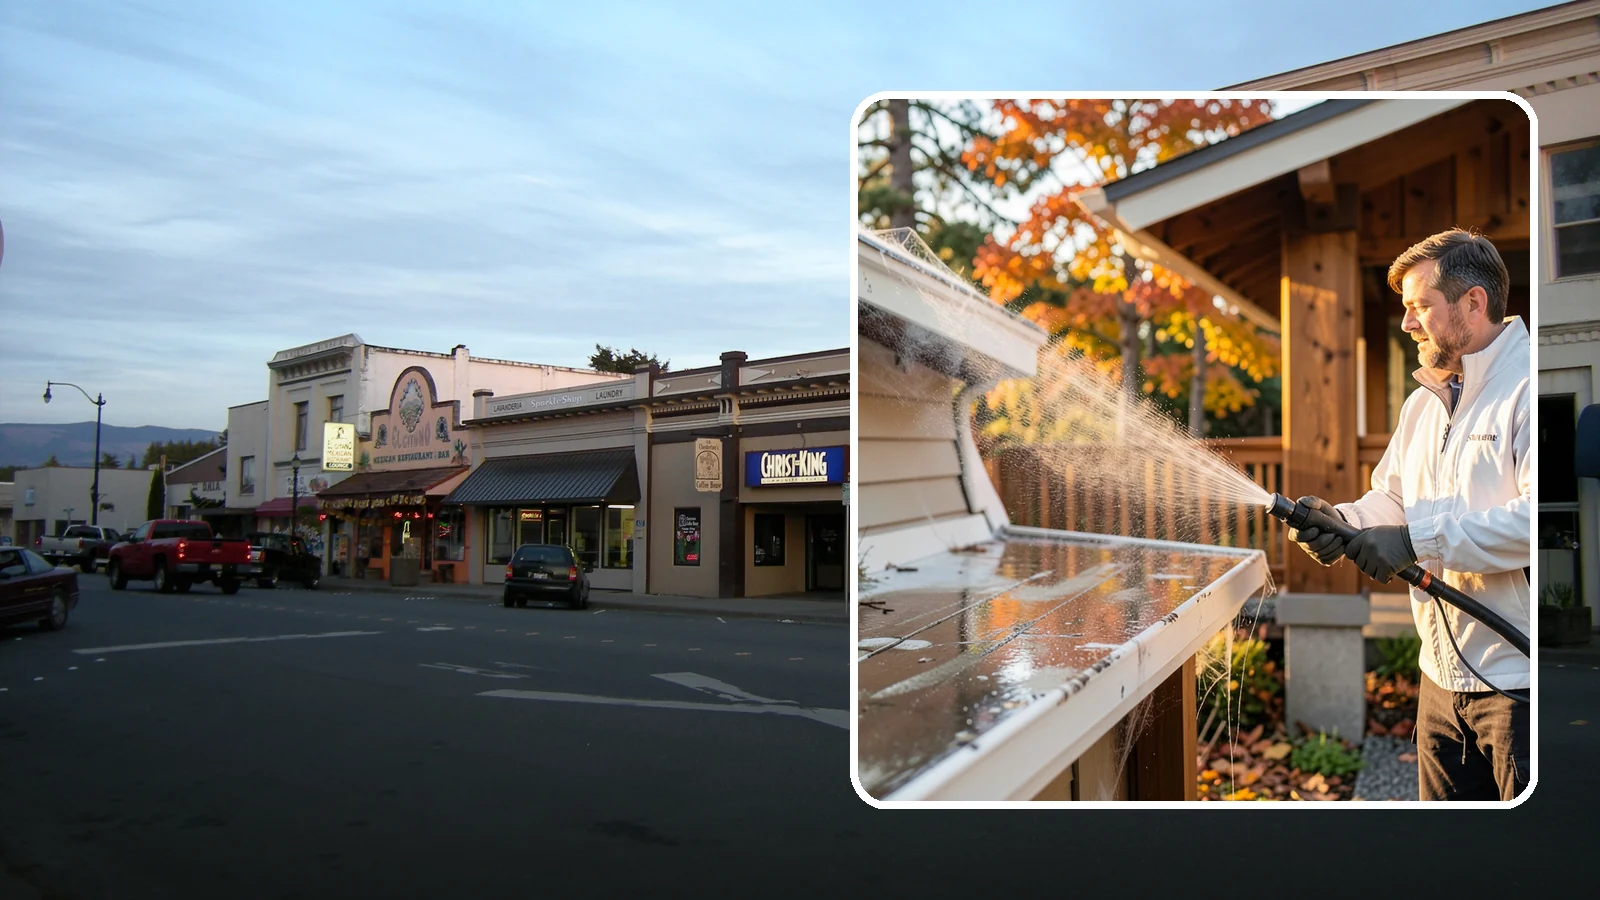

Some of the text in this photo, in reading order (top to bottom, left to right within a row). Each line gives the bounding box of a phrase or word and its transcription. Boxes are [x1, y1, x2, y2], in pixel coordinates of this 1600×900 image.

[530, 394, 583, 409] Sparkle Shop
[595, 389, 623, 400] LAUNDRY
[493, 402, 522, 413] LAVANDERIA
[373, 455, 396, 465] MEXICAN
[397, 451, 433, 462] RESTAURANT
[438, 450, 450, 459] BAR
[761, 450, 828, 478] CHRIST KING
